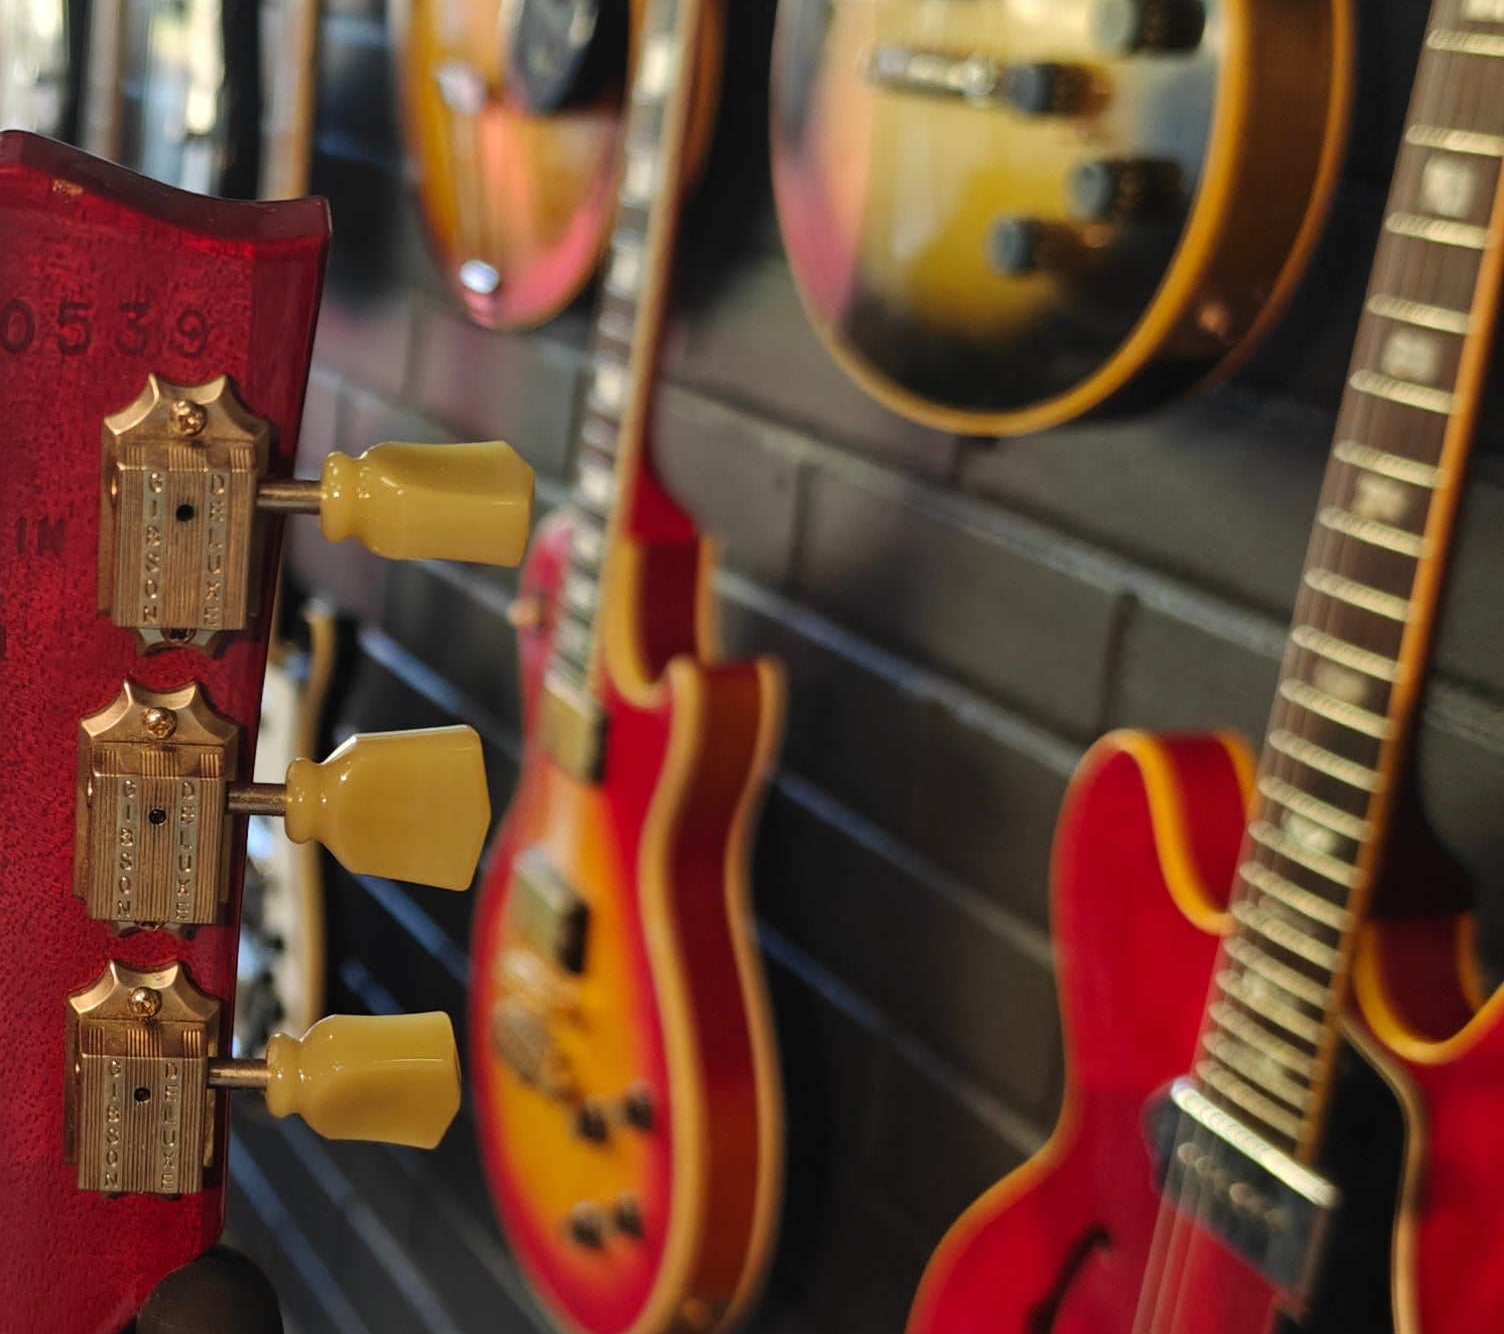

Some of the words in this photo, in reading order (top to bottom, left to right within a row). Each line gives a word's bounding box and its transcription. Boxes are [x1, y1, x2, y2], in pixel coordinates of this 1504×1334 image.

[15, 515, 66, 556] IN
[142, 471, 163, 625] GIBSON
[203, 473, 225, 627] DELUXE
[117, 779, 137, 918] GIBSON
[175, 781, 195, 920] DELUXE
[104, 1059, 122, 1189] GIBSON
[160, 1062, 179, 1191] DELUXE
